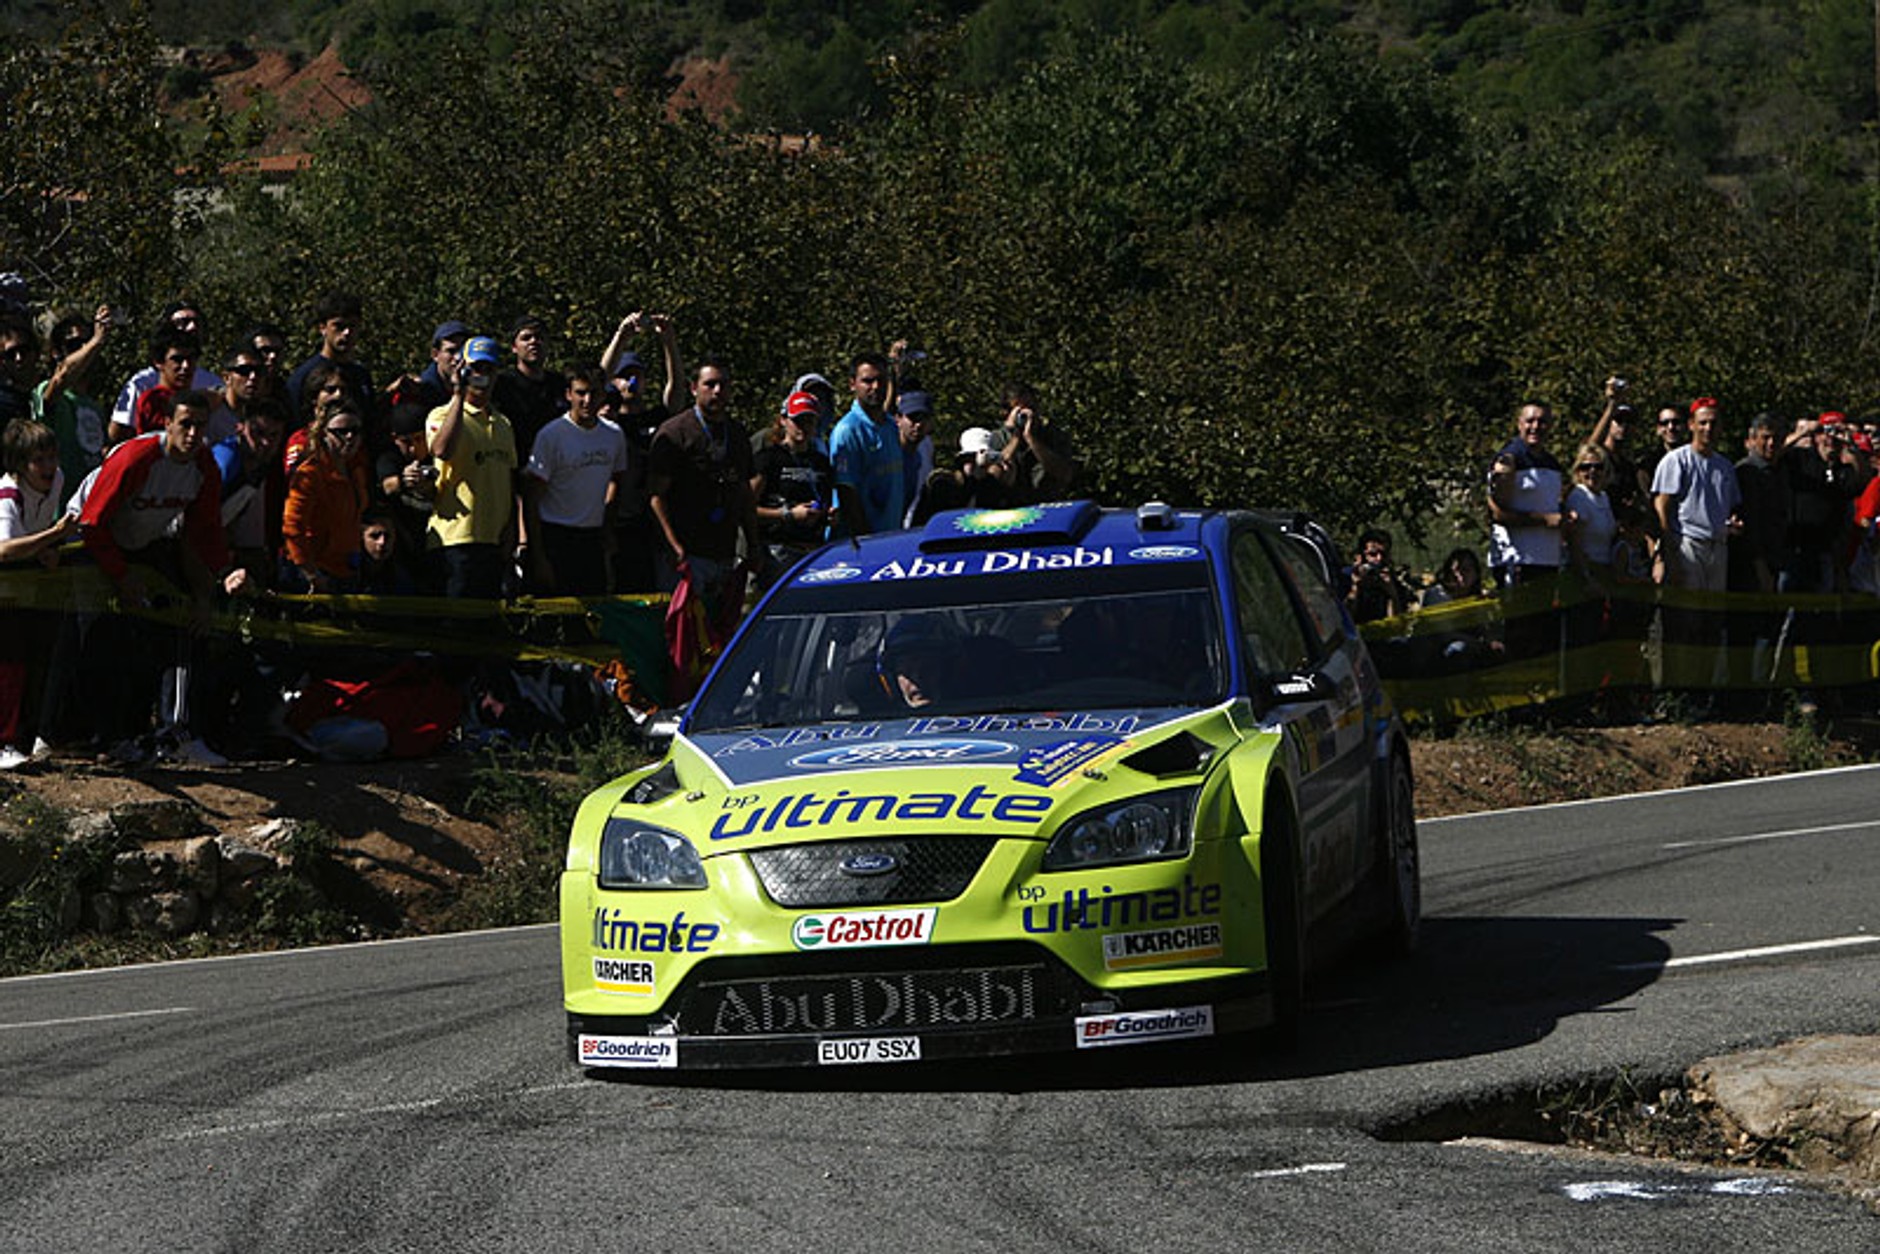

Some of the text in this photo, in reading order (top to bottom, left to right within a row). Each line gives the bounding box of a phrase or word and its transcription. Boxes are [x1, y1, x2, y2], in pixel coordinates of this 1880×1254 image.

[869, 557, 965, 581] Abu
[981, 546, 1113, 573] Dhabi
[713, 712, 1140, 758] Abu Dhabi
[826, 744, 978, 764] Ford
[709, 785, 1054, 840] ultimate
[722, 795, 760, 809] bp
[850, 855, 881, 868] Ford
[1017, 883, 1046, 902] bp
[1023, 874, 1221, 933] ultimate
[827, 913, 925, 944] Castrol
[714, 969, 1036, 1035] Abu Dhabi
[1084, 1011, 1207, 1037] BFGoodrich
[582, 1039, 671, 1056] BFGoodrich
[822, 1039, 918, 1061] EU07 SSX
